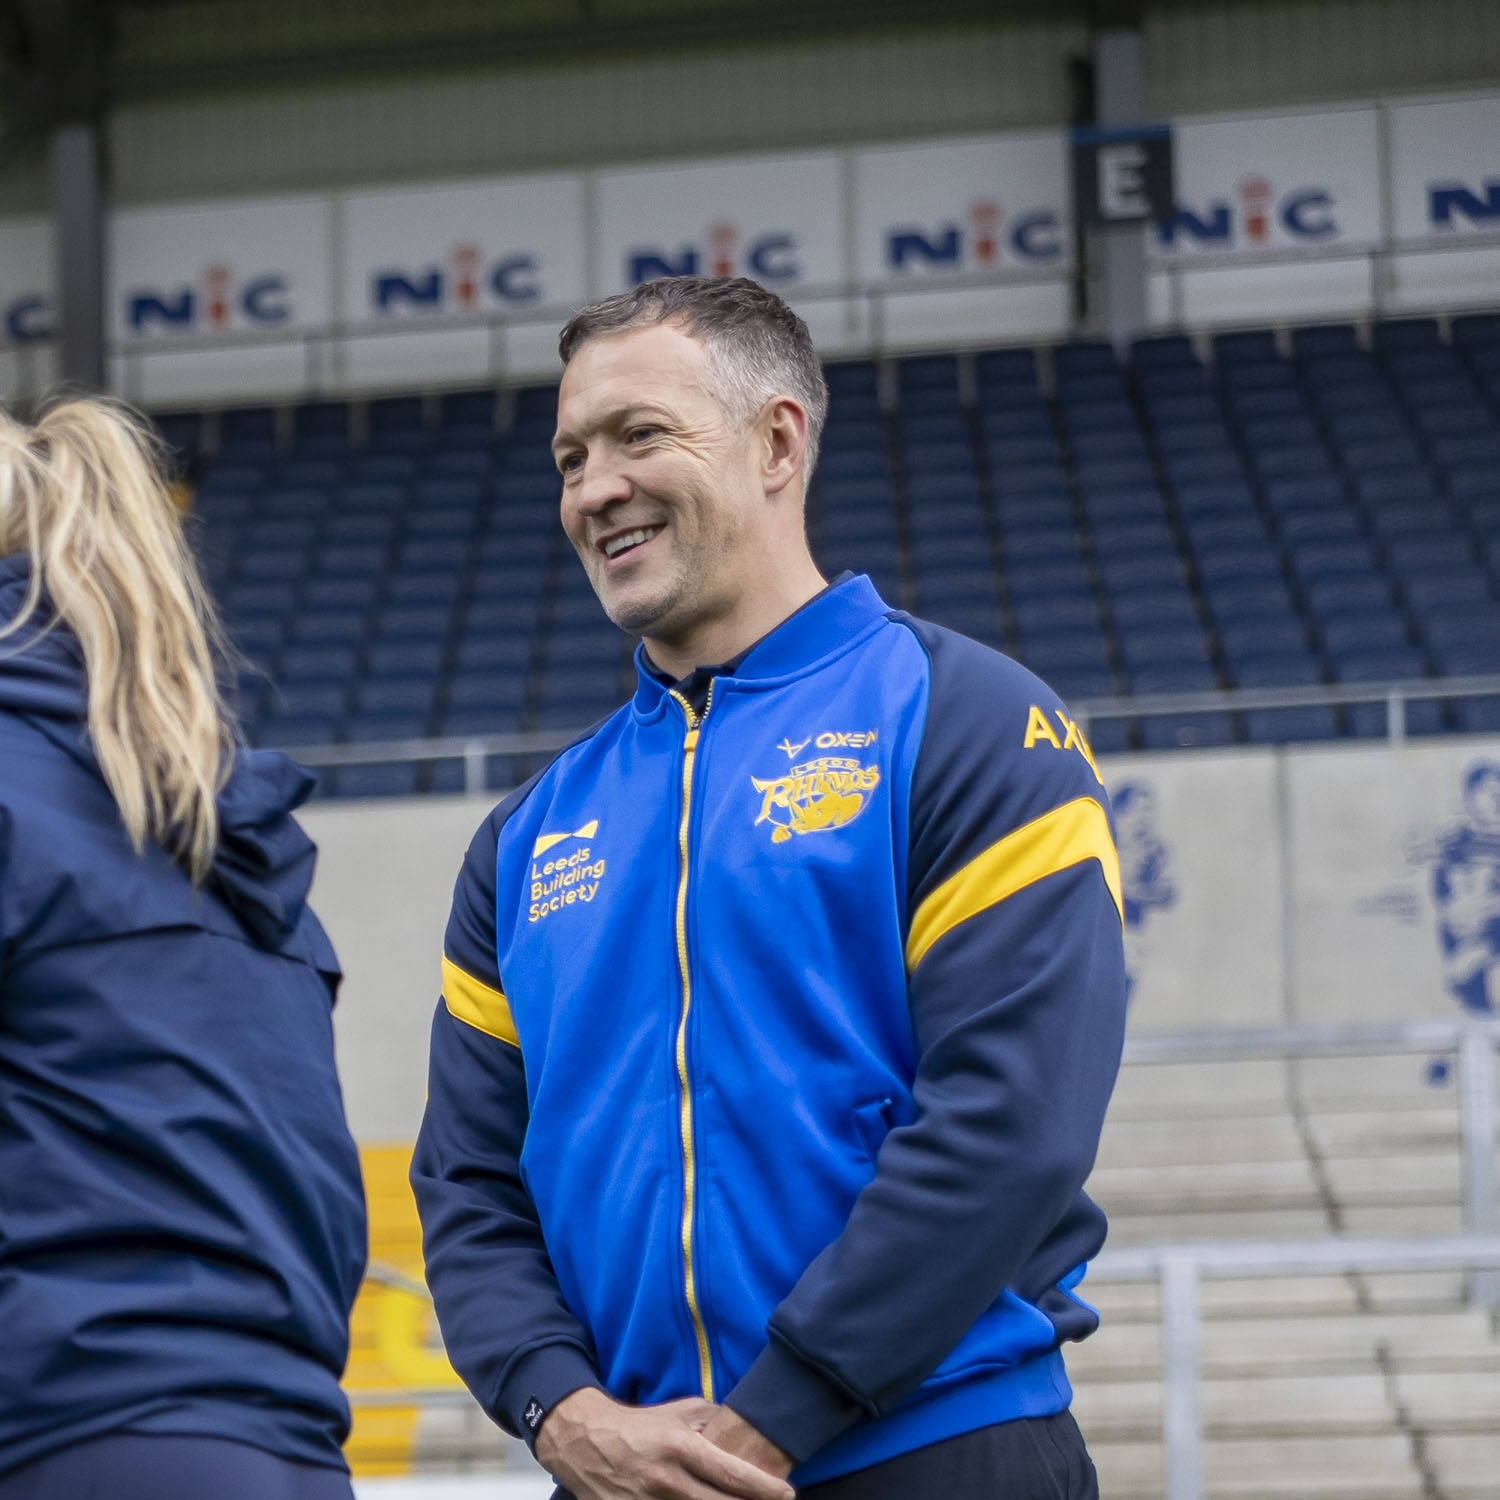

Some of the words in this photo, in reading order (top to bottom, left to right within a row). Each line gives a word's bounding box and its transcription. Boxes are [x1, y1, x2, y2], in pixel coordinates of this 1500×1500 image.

[1100, 146, 1149, 219] E
[816, 729, 878, 748] OXEN
[530, 860, 605, 901] Building
[531, 848, 590, 880] Leeds
[528, 881, 600, 922] Society
